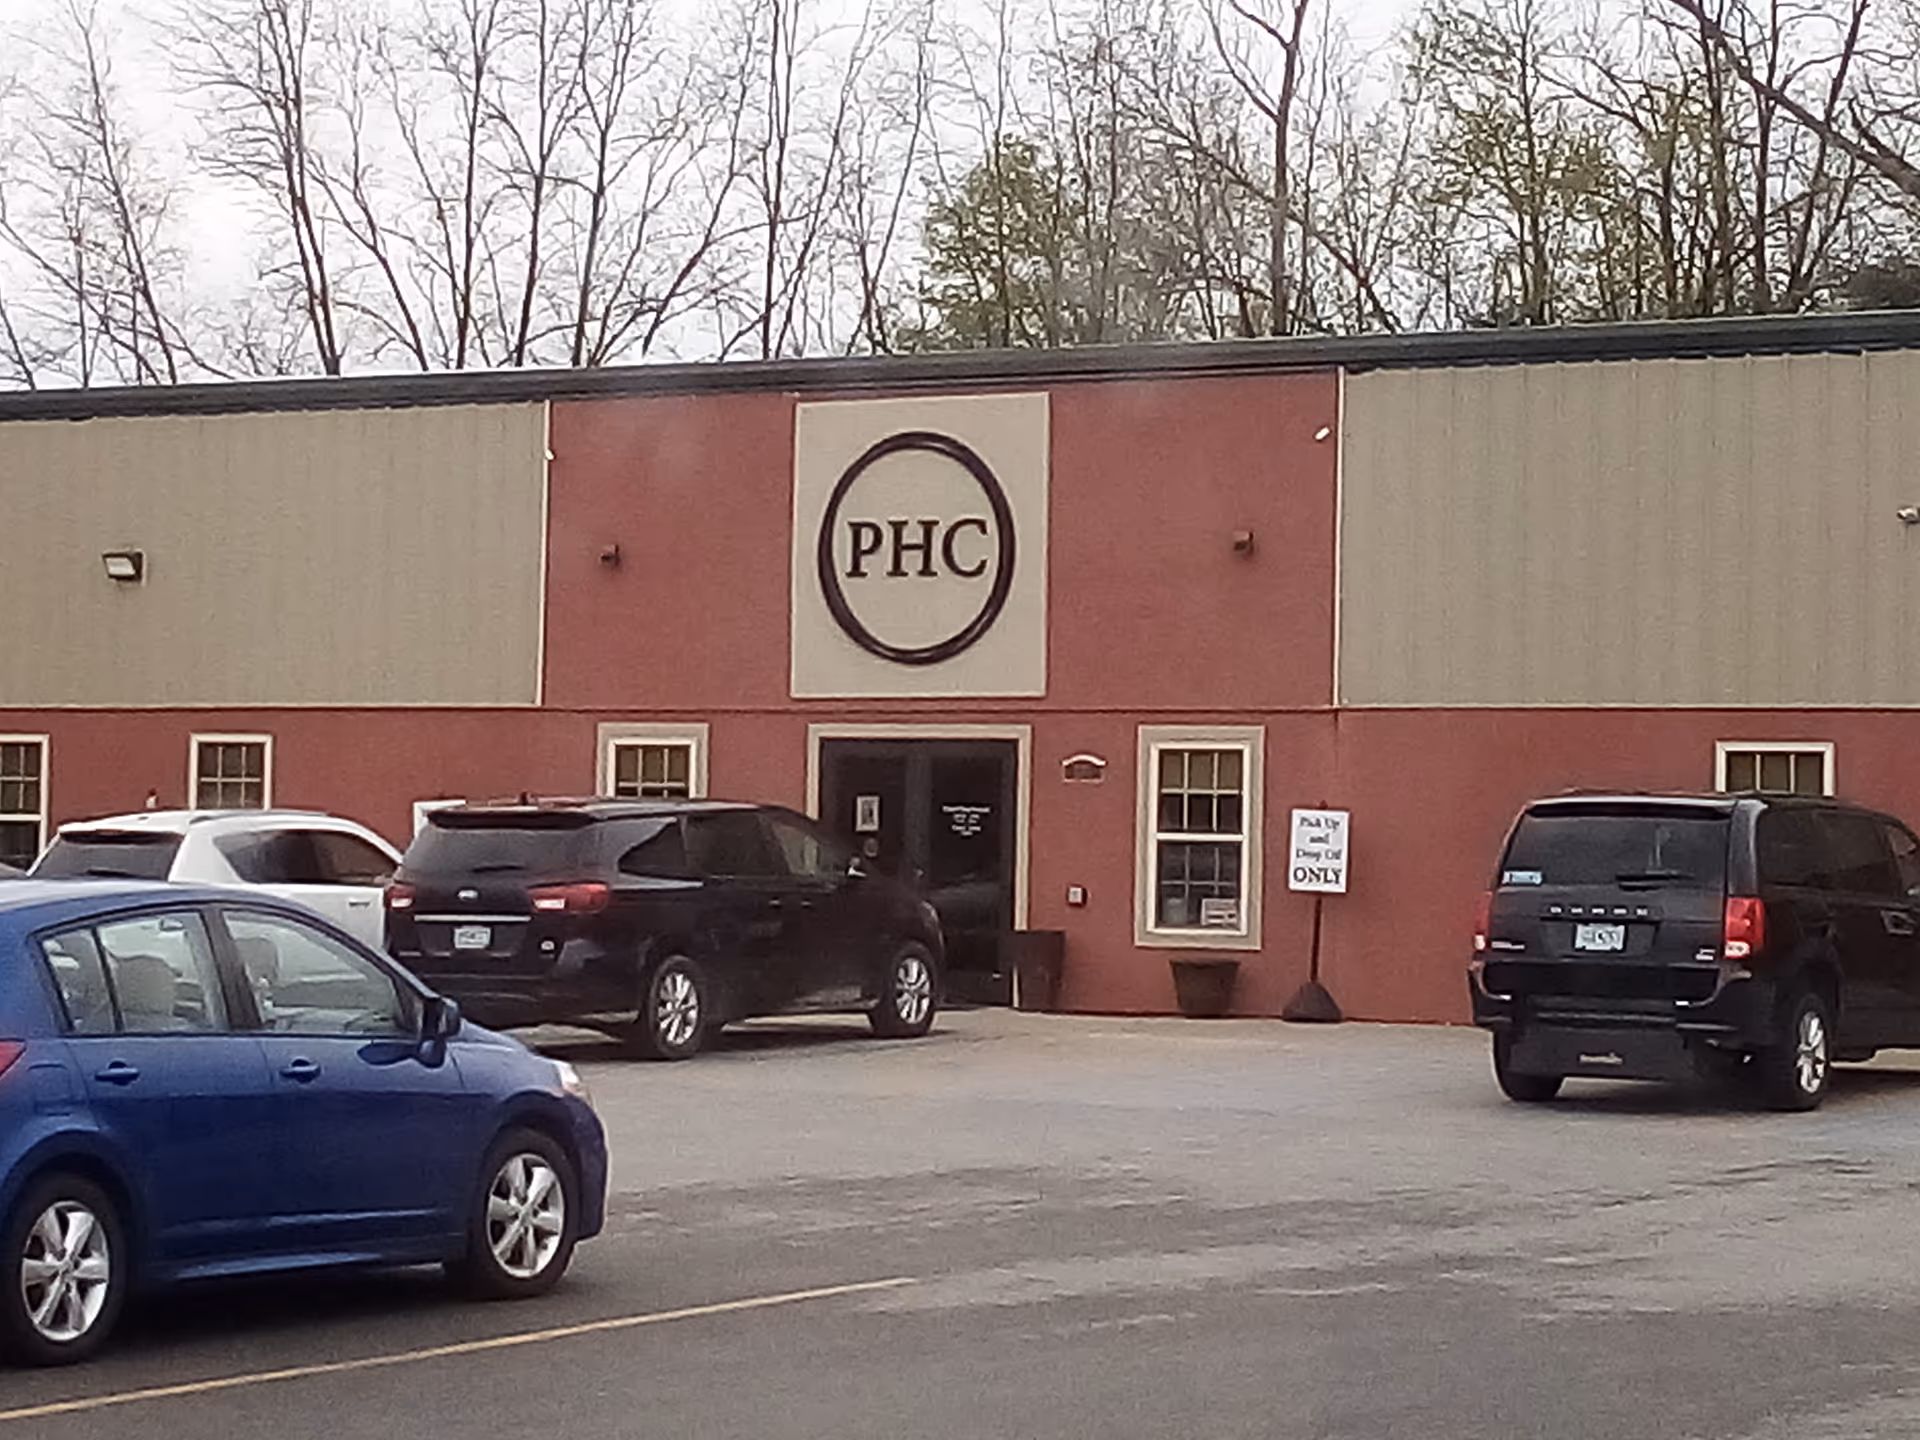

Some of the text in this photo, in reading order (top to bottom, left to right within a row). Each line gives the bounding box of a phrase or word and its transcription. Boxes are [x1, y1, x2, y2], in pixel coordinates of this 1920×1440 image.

[845, 518, 988, 578] PHC
[1324, 818, 1340, 832] Up
[1293, 866, 1342, 884] ONLY
